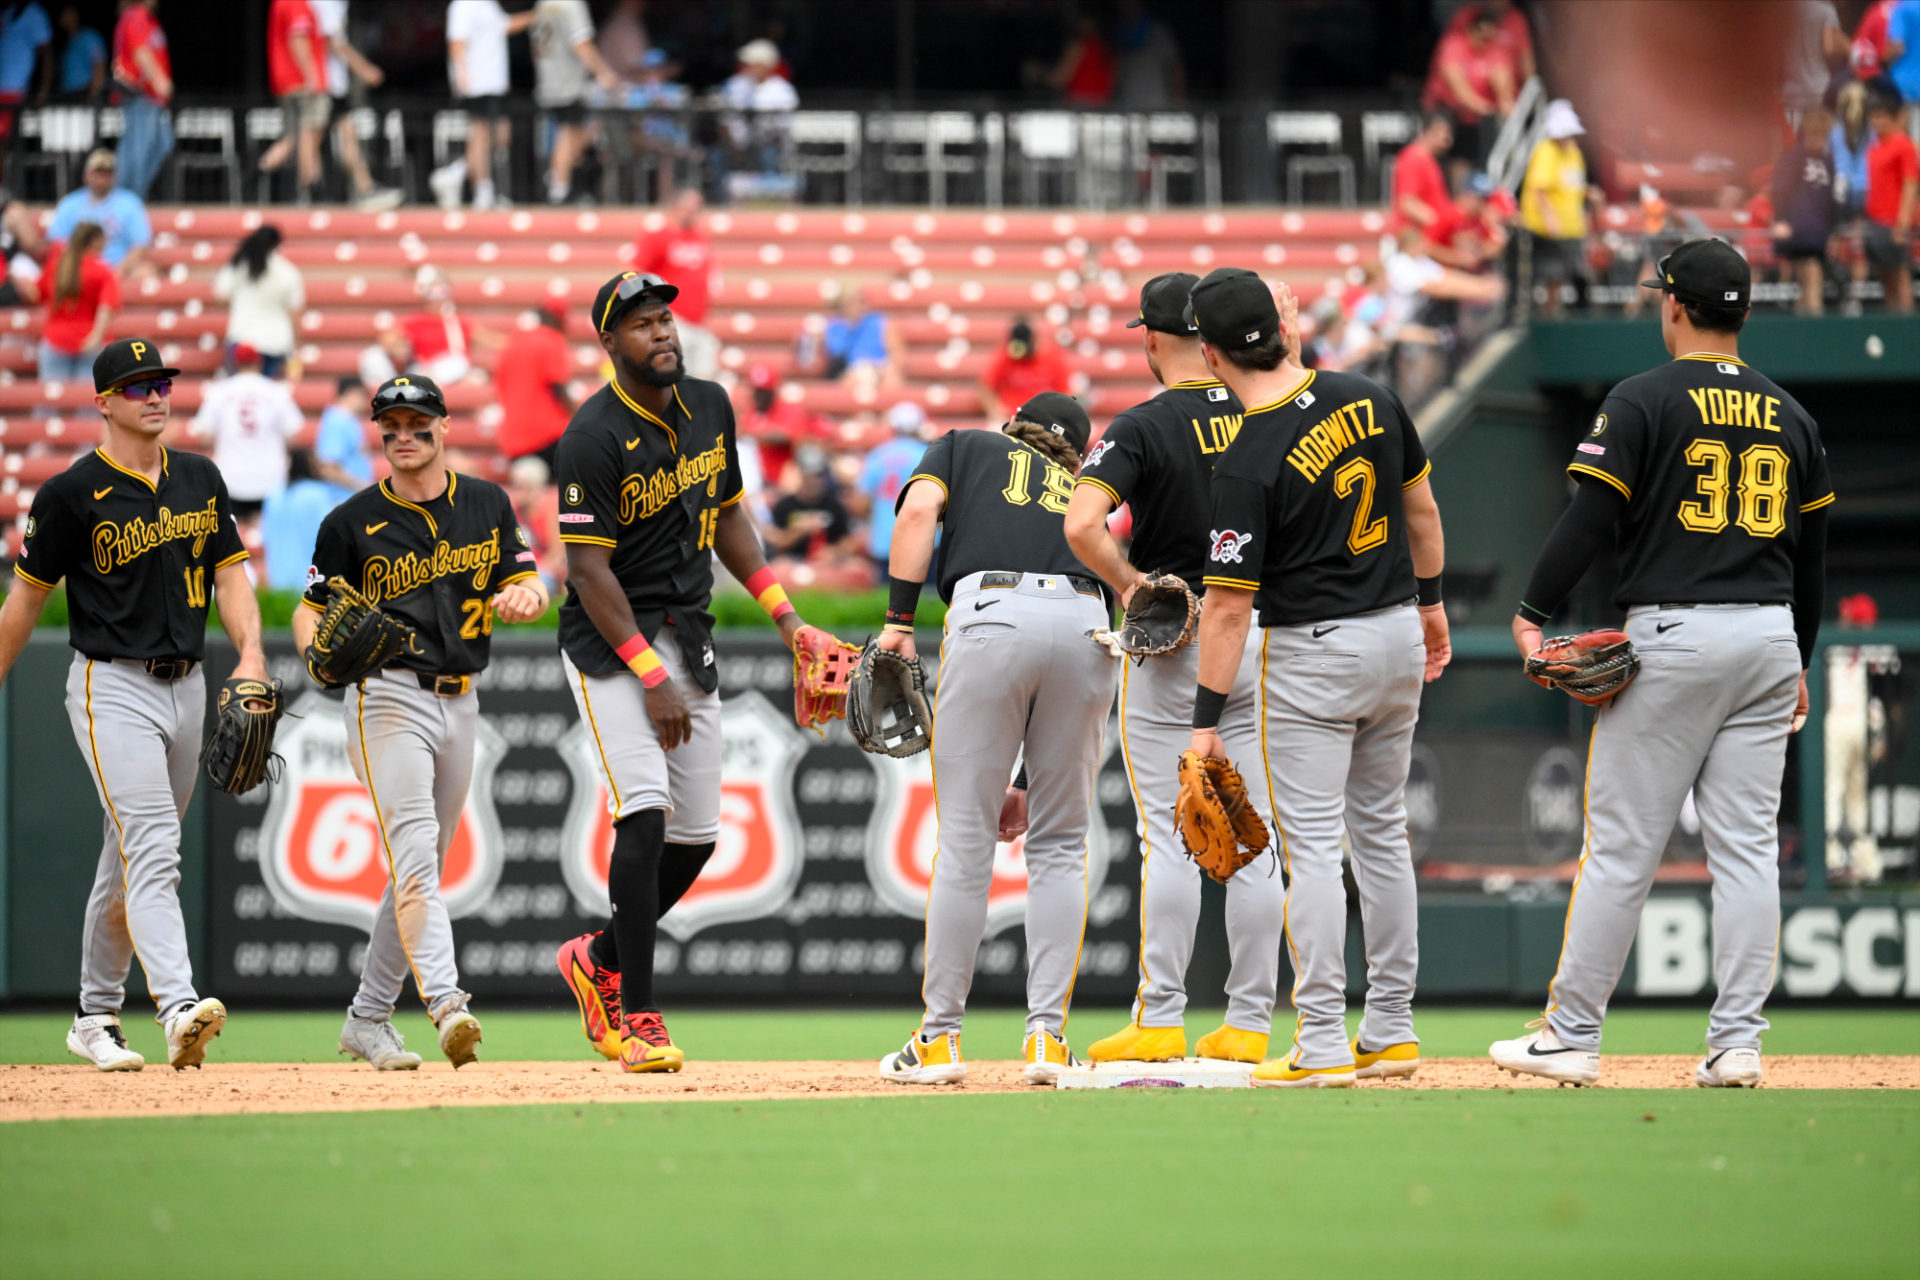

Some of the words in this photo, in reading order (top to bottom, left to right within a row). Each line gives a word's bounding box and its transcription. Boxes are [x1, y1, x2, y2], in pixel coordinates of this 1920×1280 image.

[131, 341, 146, 361] P
[1192, 414, 1244, 454] LOW
[1286, 399, 1384, 484] HORWITZ
[1688, 388, 1781, 432] YORKE
[568, 486, 578, 502] 9
[617, 432, 727, 525] Pittsburgh
[1001, 449, 1078, 515] 19
[1334, 456, 1388, 556] 2
[1677, 438, 1791, 538] 38
[92, 496, 219, 574] Pittsburgh
[697, 508, 719, 551] 15
[184, 566, 205, 608] 10
[305, 791, 391, 882] 6
[1636, 898, 1920, 997] BSC
